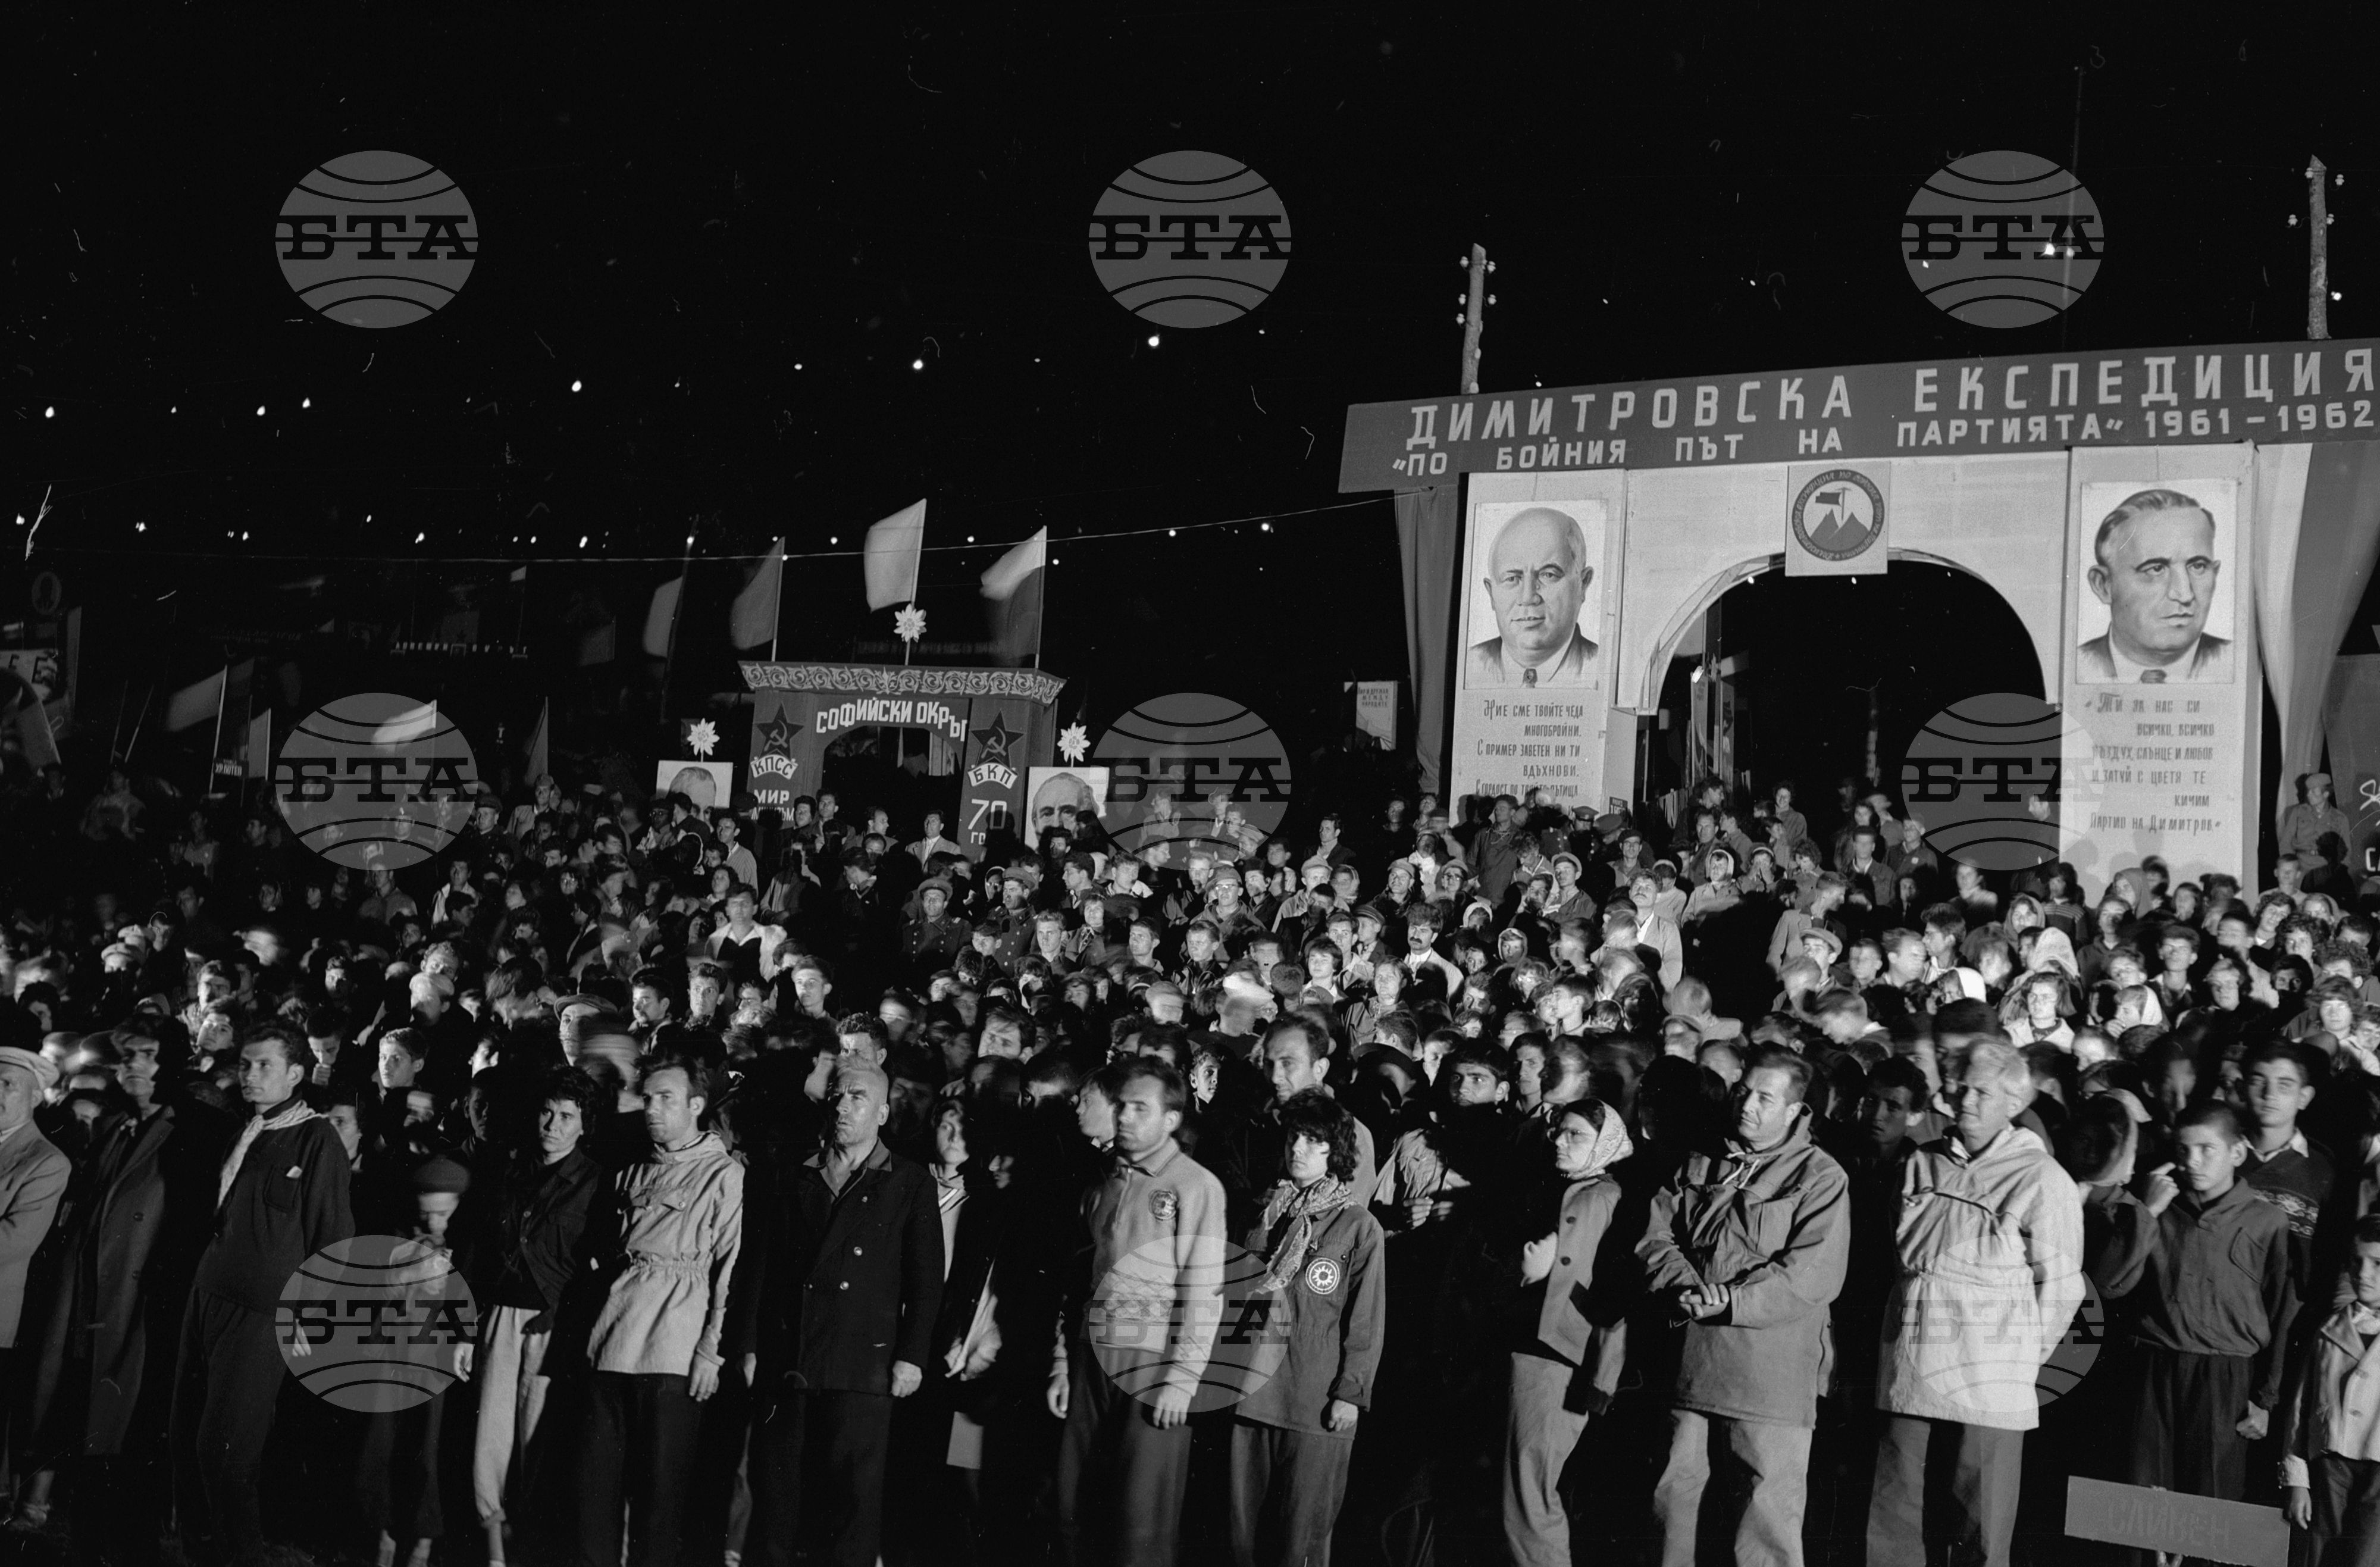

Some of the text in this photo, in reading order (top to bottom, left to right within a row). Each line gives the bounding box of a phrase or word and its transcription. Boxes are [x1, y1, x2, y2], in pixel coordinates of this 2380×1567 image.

[1406, 349, 2375, 451] ДИМИТРОВСКА ЕКСПЕДИЦИЯ
[1496, 436, 1626, 470] БОЙНИЯ
[1676, 433, 1743, 461] ПЪТ
[1799, 426, 1842, 455] НА
[1484, 699, 1583, 720] НИЕ СМЕ ТВОЙТЕ ЧЕДА
[2133, 699, 2144, 712] ЗА
[2155, 700, 2173, 713] НАС
[2187, 700, 2200, 713] СИ
[816, 697, 967, 742] СОФИЙСКИ ОКРЪГ
[1524, 722, 1582, 737] МНОГОБРОЙНИ.
[2179, 723, 2215, 737] ВСИЧКО
[1477, 739, 1580, 757] С ПРИМЕР ЗАВЕТЕН НИ ТИ
[2137, 746, 2171, 761] СЛЪНЦЕ
[2175, 747, 2181, 760] И
[2184, 746, 2213, 760] ЛЮБОВ
[754, 756, 793, 775] КПСС
[1523, 765, 1579, 779] ВДЪХНОВИ.
[973, 765, 1012, 785] БКП
[2150, 770, 2182, 787] ЦВЕТЯ
[2193, 770, 2206, 784] ТЕ
[754, 789, 790, 804] МИР
[2175, 795, 2209, 807] КИЧИМ
[968, 799, 1007, 830] 70
[2132, 817, 2143, 830] НА
[2107, 1498, 2229, 1550] СЛИВЕН
